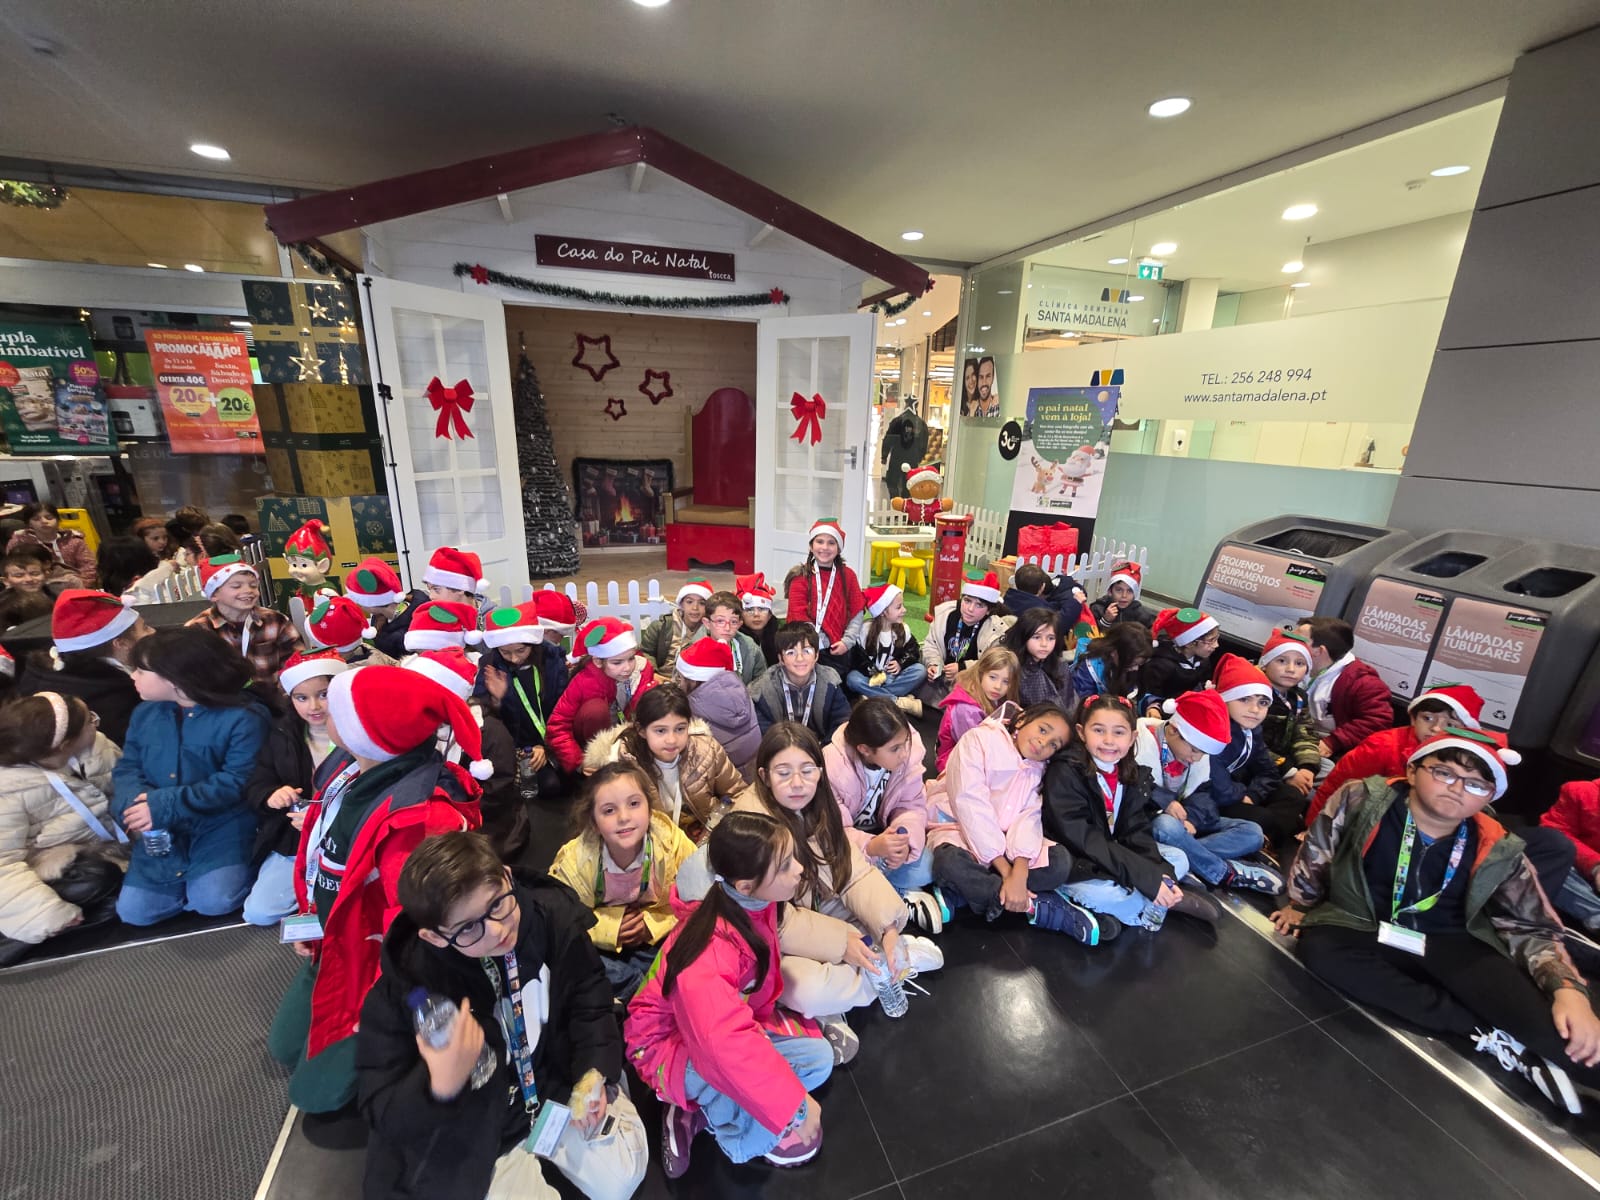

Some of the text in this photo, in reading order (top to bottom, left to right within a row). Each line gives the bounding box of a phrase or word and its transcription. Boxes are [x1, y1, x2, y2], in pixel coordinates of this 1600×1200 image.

[557, 243, 710, 271] Casa do Pai Natal
[1037, 309, 1127, 328] SANTA MADALENA
[186, 376, 205, 384] 40€
[211, 377, 248, 385] Domingo
[1231, 371, 1254, 384] 256
[1257, 370, 1282, 383] 248
[1286, 368, 1312, 382] 994
[172, 388, 206, 403] 20€
[221, 397, 251, 411] 20€
[1184, 388, 1327, 404] www.santamadalena.pt
[1045, 404, 1061, 414] pai
[1063, 403, 1089, 412] natal
[1070, 413, 1092, 423] loja!
[1219, 554, 1265, 573] PEQUENOS
[1216, 563, 1282, 588] EQUIPAMENTOS
[1364, 605, 1428, 631] LÂMPADAS
[1361, 615, 1433, 643] COMPACTAS
[1445, 625, 1524, 652] LÂMPADAS
[1443, 637, 1521, 664] TUBULARES
